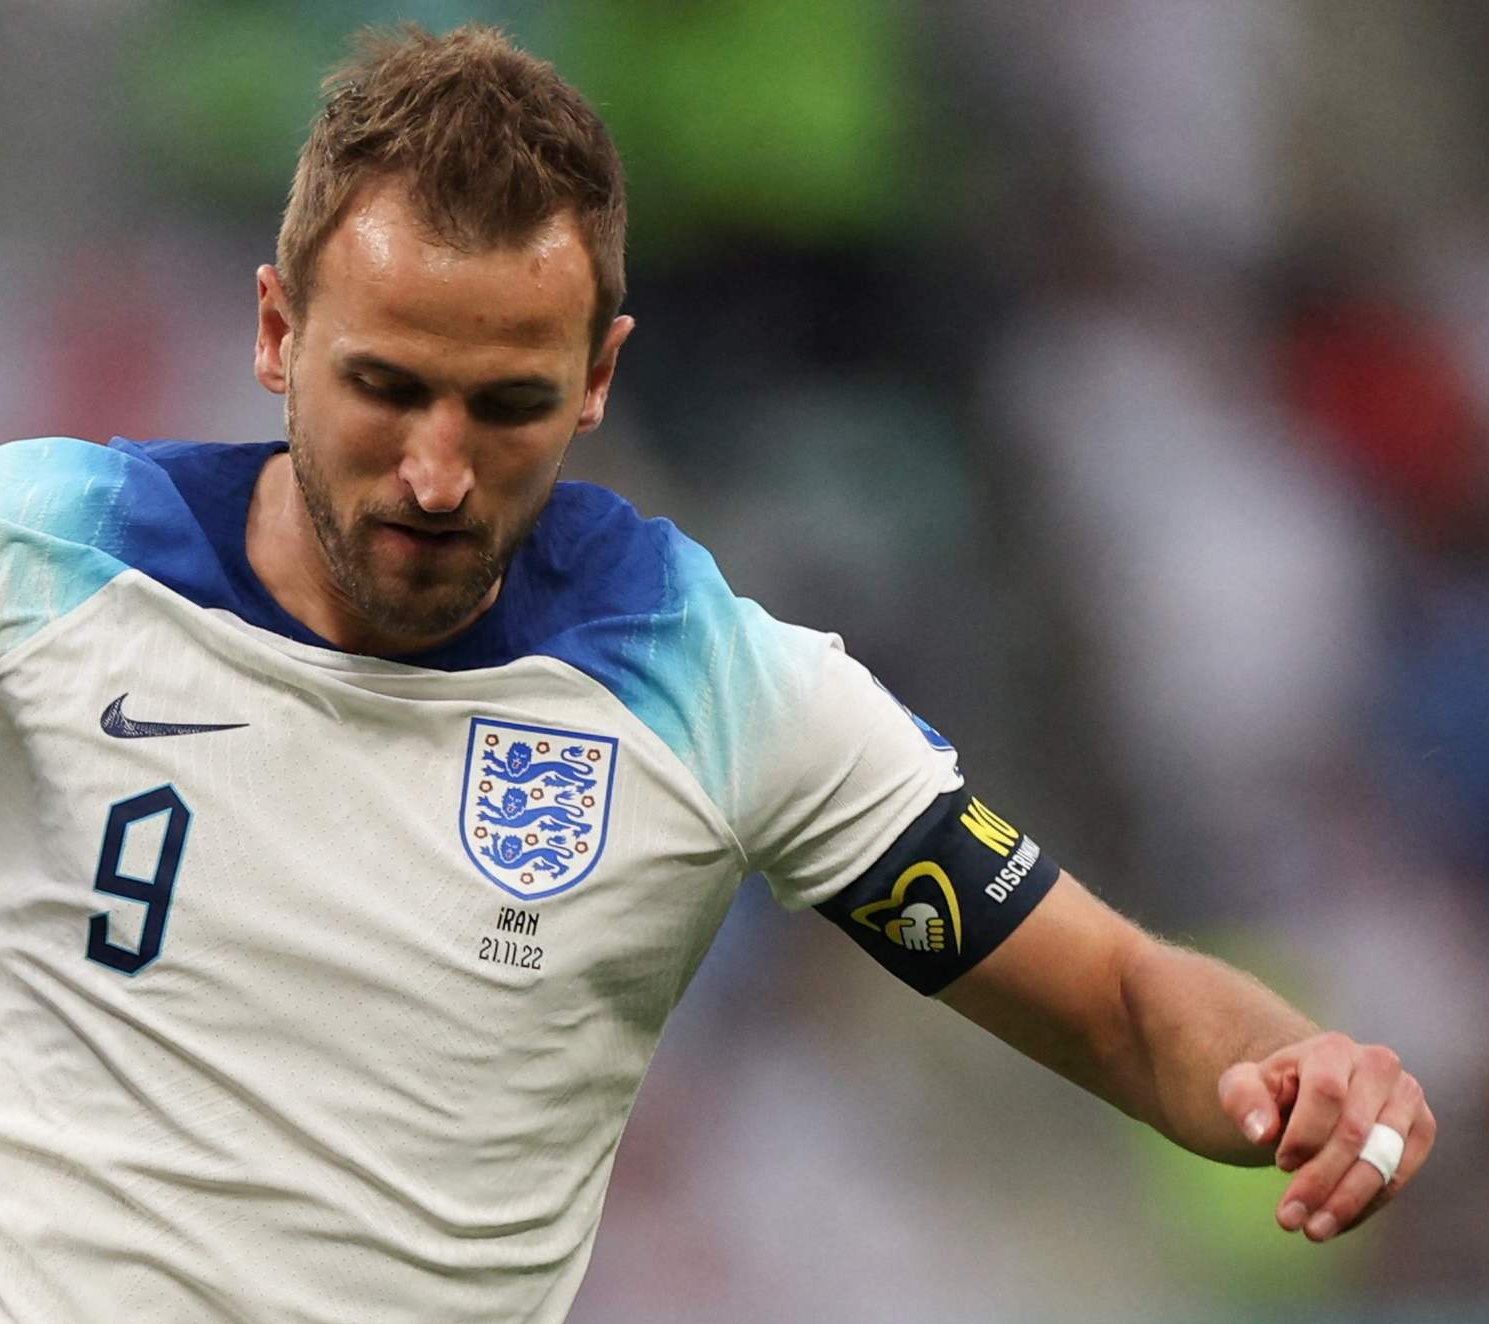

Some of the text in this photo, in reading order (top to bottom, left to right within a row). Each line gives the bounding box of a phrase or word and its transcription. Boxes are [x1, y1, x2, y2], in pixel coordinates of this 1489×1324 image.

[960, 795, 1019, 857] NO
[85, 782, 194, 977] 9
[478, 936, 544, 970] 21.11.22
